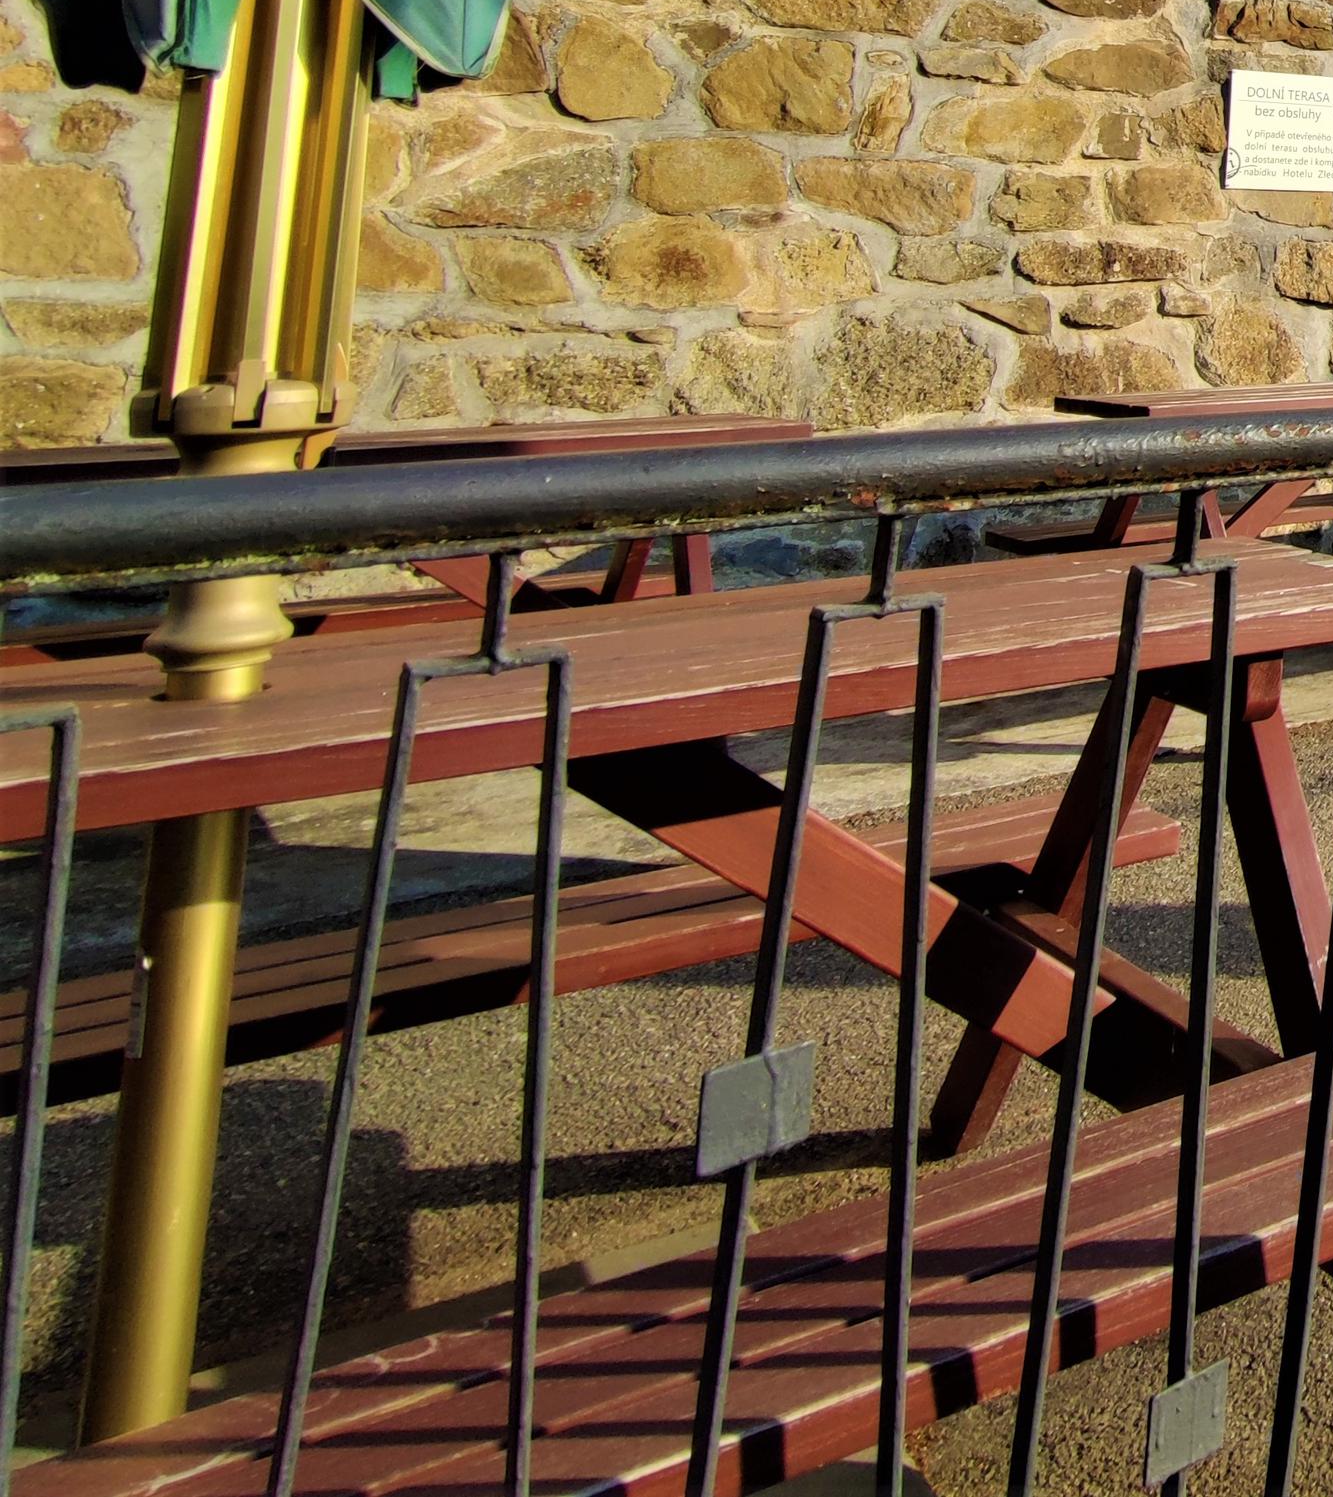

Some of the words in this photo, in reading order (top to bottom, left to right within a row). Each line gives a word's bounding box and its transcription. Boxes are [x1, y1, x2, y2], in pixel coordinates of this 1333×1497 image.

[1247, 86, 1285, 100] DOLNÍ
[1288, 89, 1330, 103] TERASA
[1255, 105, 1275, 117] bez
[1278, 107, 1321, 123] obsluhy
[1246, 129, 1253, 137] V
[1271, 144, 1298, 153] terasu
[1252, 155, 1292, 165] dostanete
[1294, 157, 1308, 166] zde
[1283, 169, 1313, 178] Hotelu
